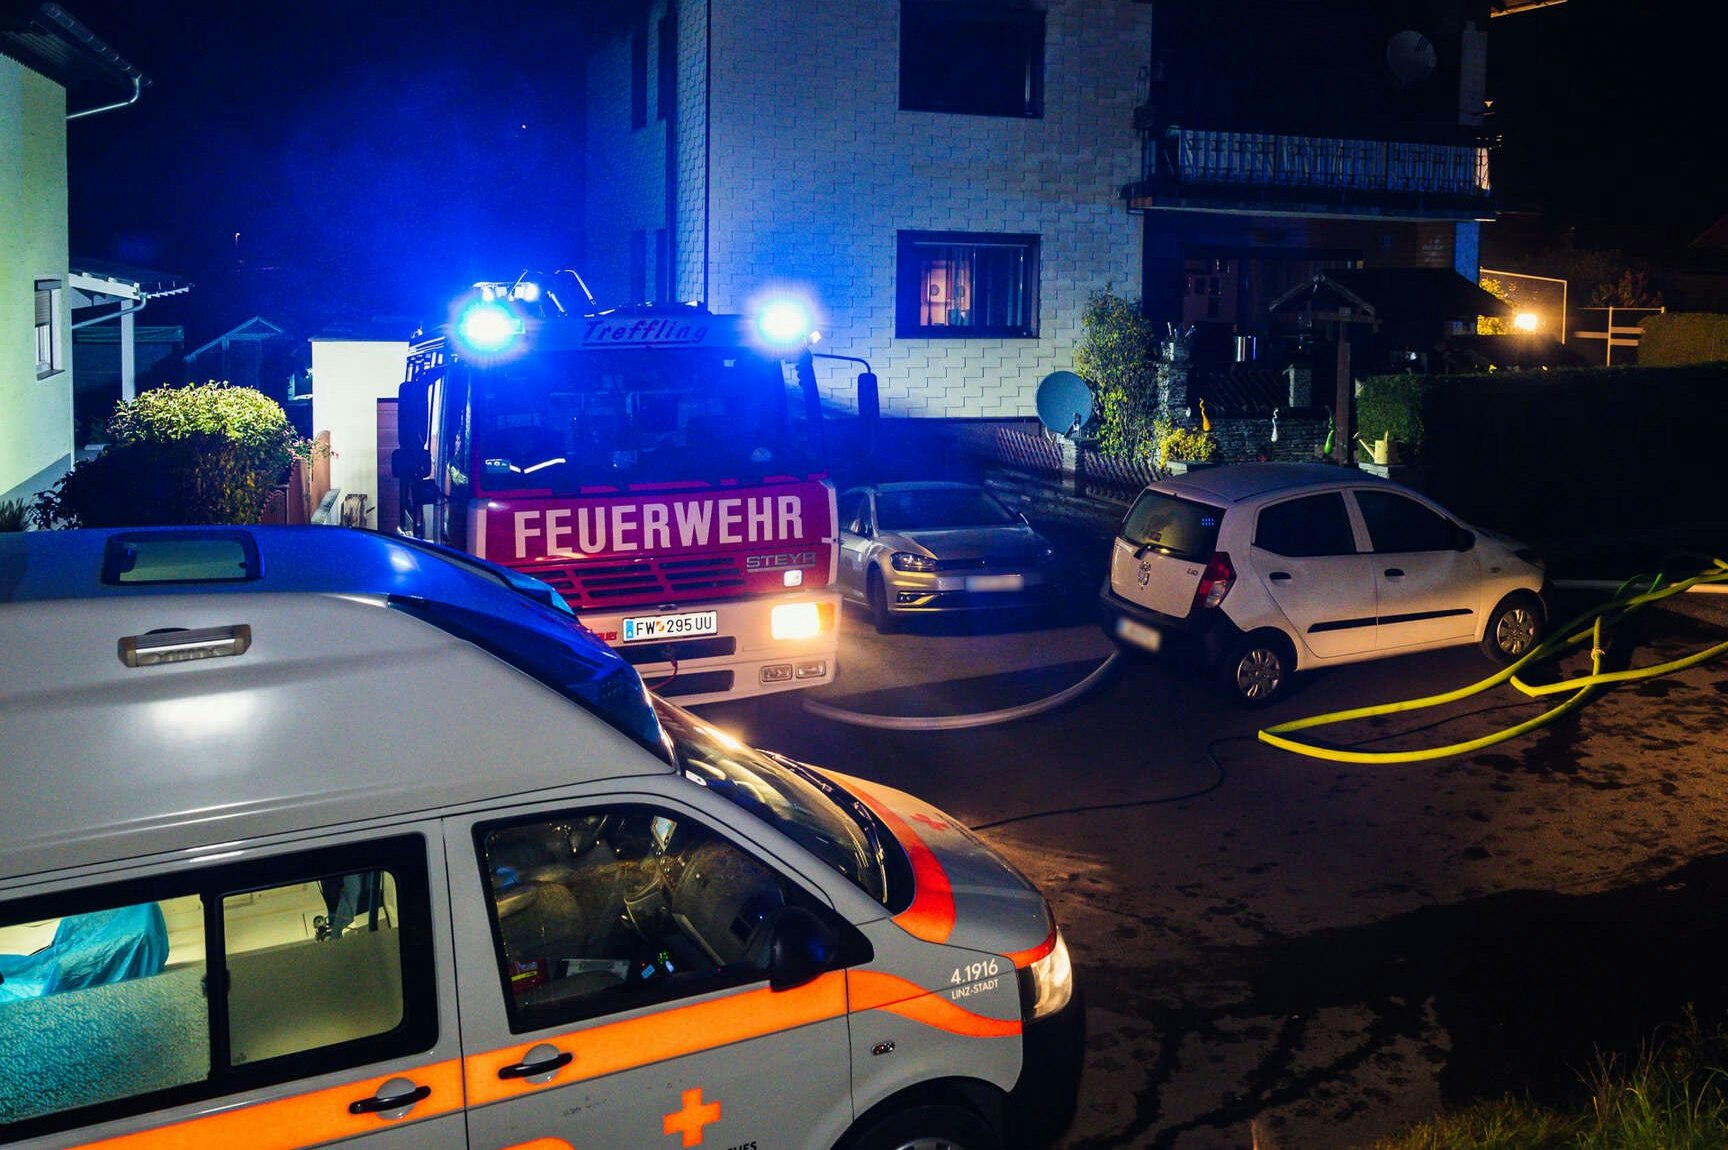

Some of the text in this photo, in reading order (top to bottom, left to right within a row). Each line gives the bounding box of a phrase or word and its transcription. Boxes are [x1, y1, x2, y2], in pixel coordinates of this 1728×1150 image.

[582, 319, 709, 344] Treffling
[514, 495, 804, 559] FEUERWEHR
[746, 551, 817, 569] STEYR
[636, 621, 655, 636] FW
[951, 958, 998, 985] 4.1916
[951, 979, 999, 1000] LINZ-STADT
